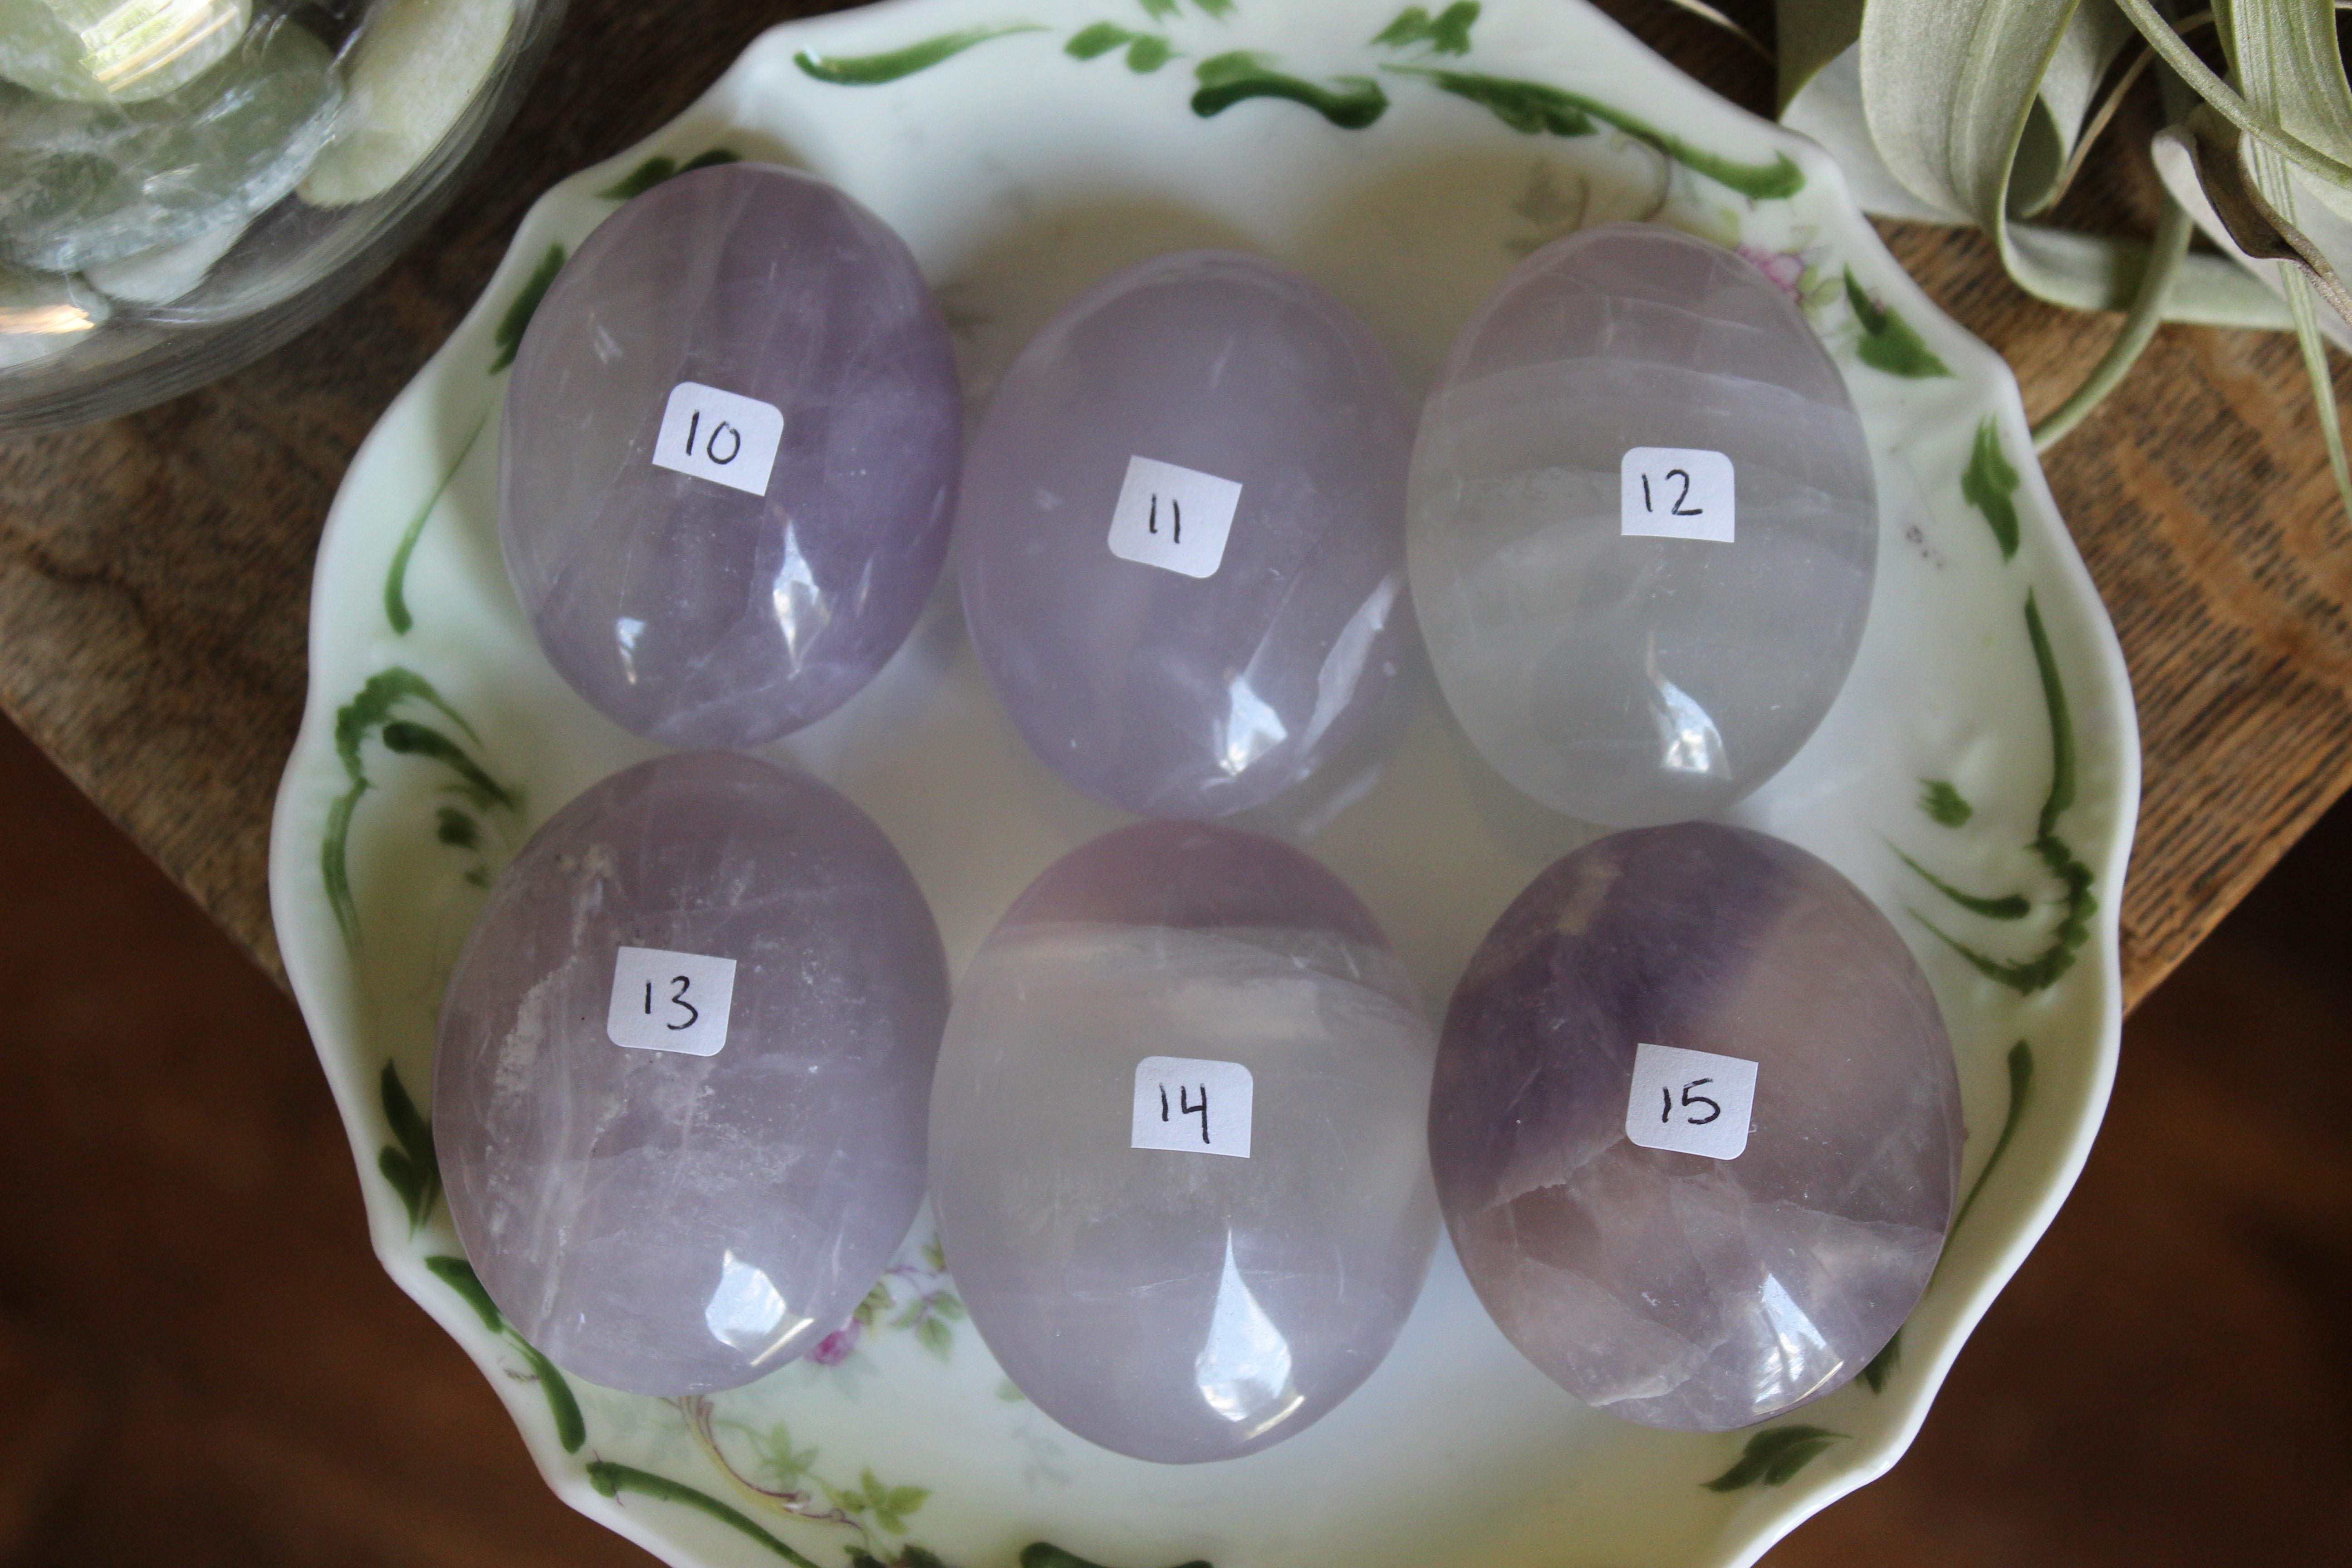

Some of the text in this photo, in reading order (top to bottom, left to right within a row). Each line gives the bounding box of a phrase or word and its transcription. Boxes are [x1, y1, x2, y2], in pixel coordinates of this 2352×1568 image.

[685, 410, 742, 466] 10
[1641, 469, 1704, 516] 12
[1148, 494, 1181, 544] 11
[643, 975, 699, 1030] 13
[1159, 1083, 1210, 1145] 14
[1660, 1077, 1721, 1126] 15
